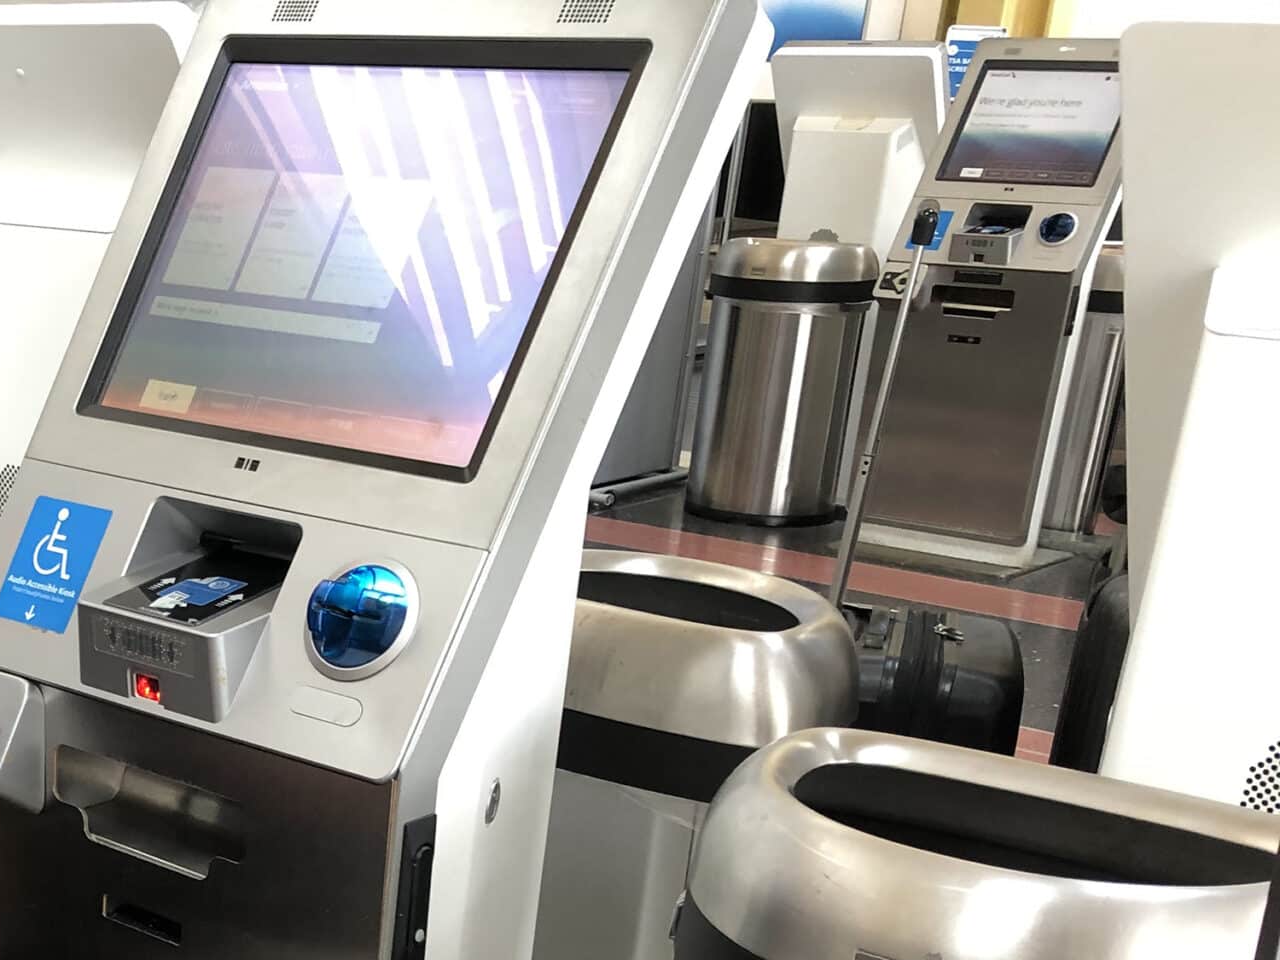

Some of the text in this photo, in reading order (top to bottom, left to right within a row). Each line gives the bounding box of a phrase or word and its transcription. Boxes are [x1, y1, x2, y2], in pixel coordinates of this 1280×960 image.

[1006, 96, 1027, 109] glad
[1061, 98, 1083, 106] here
[7, 574, 27, 586] Audio
[26, 579, 59, 594] Accessible
[58, 587, 76, 599] Kiosk
